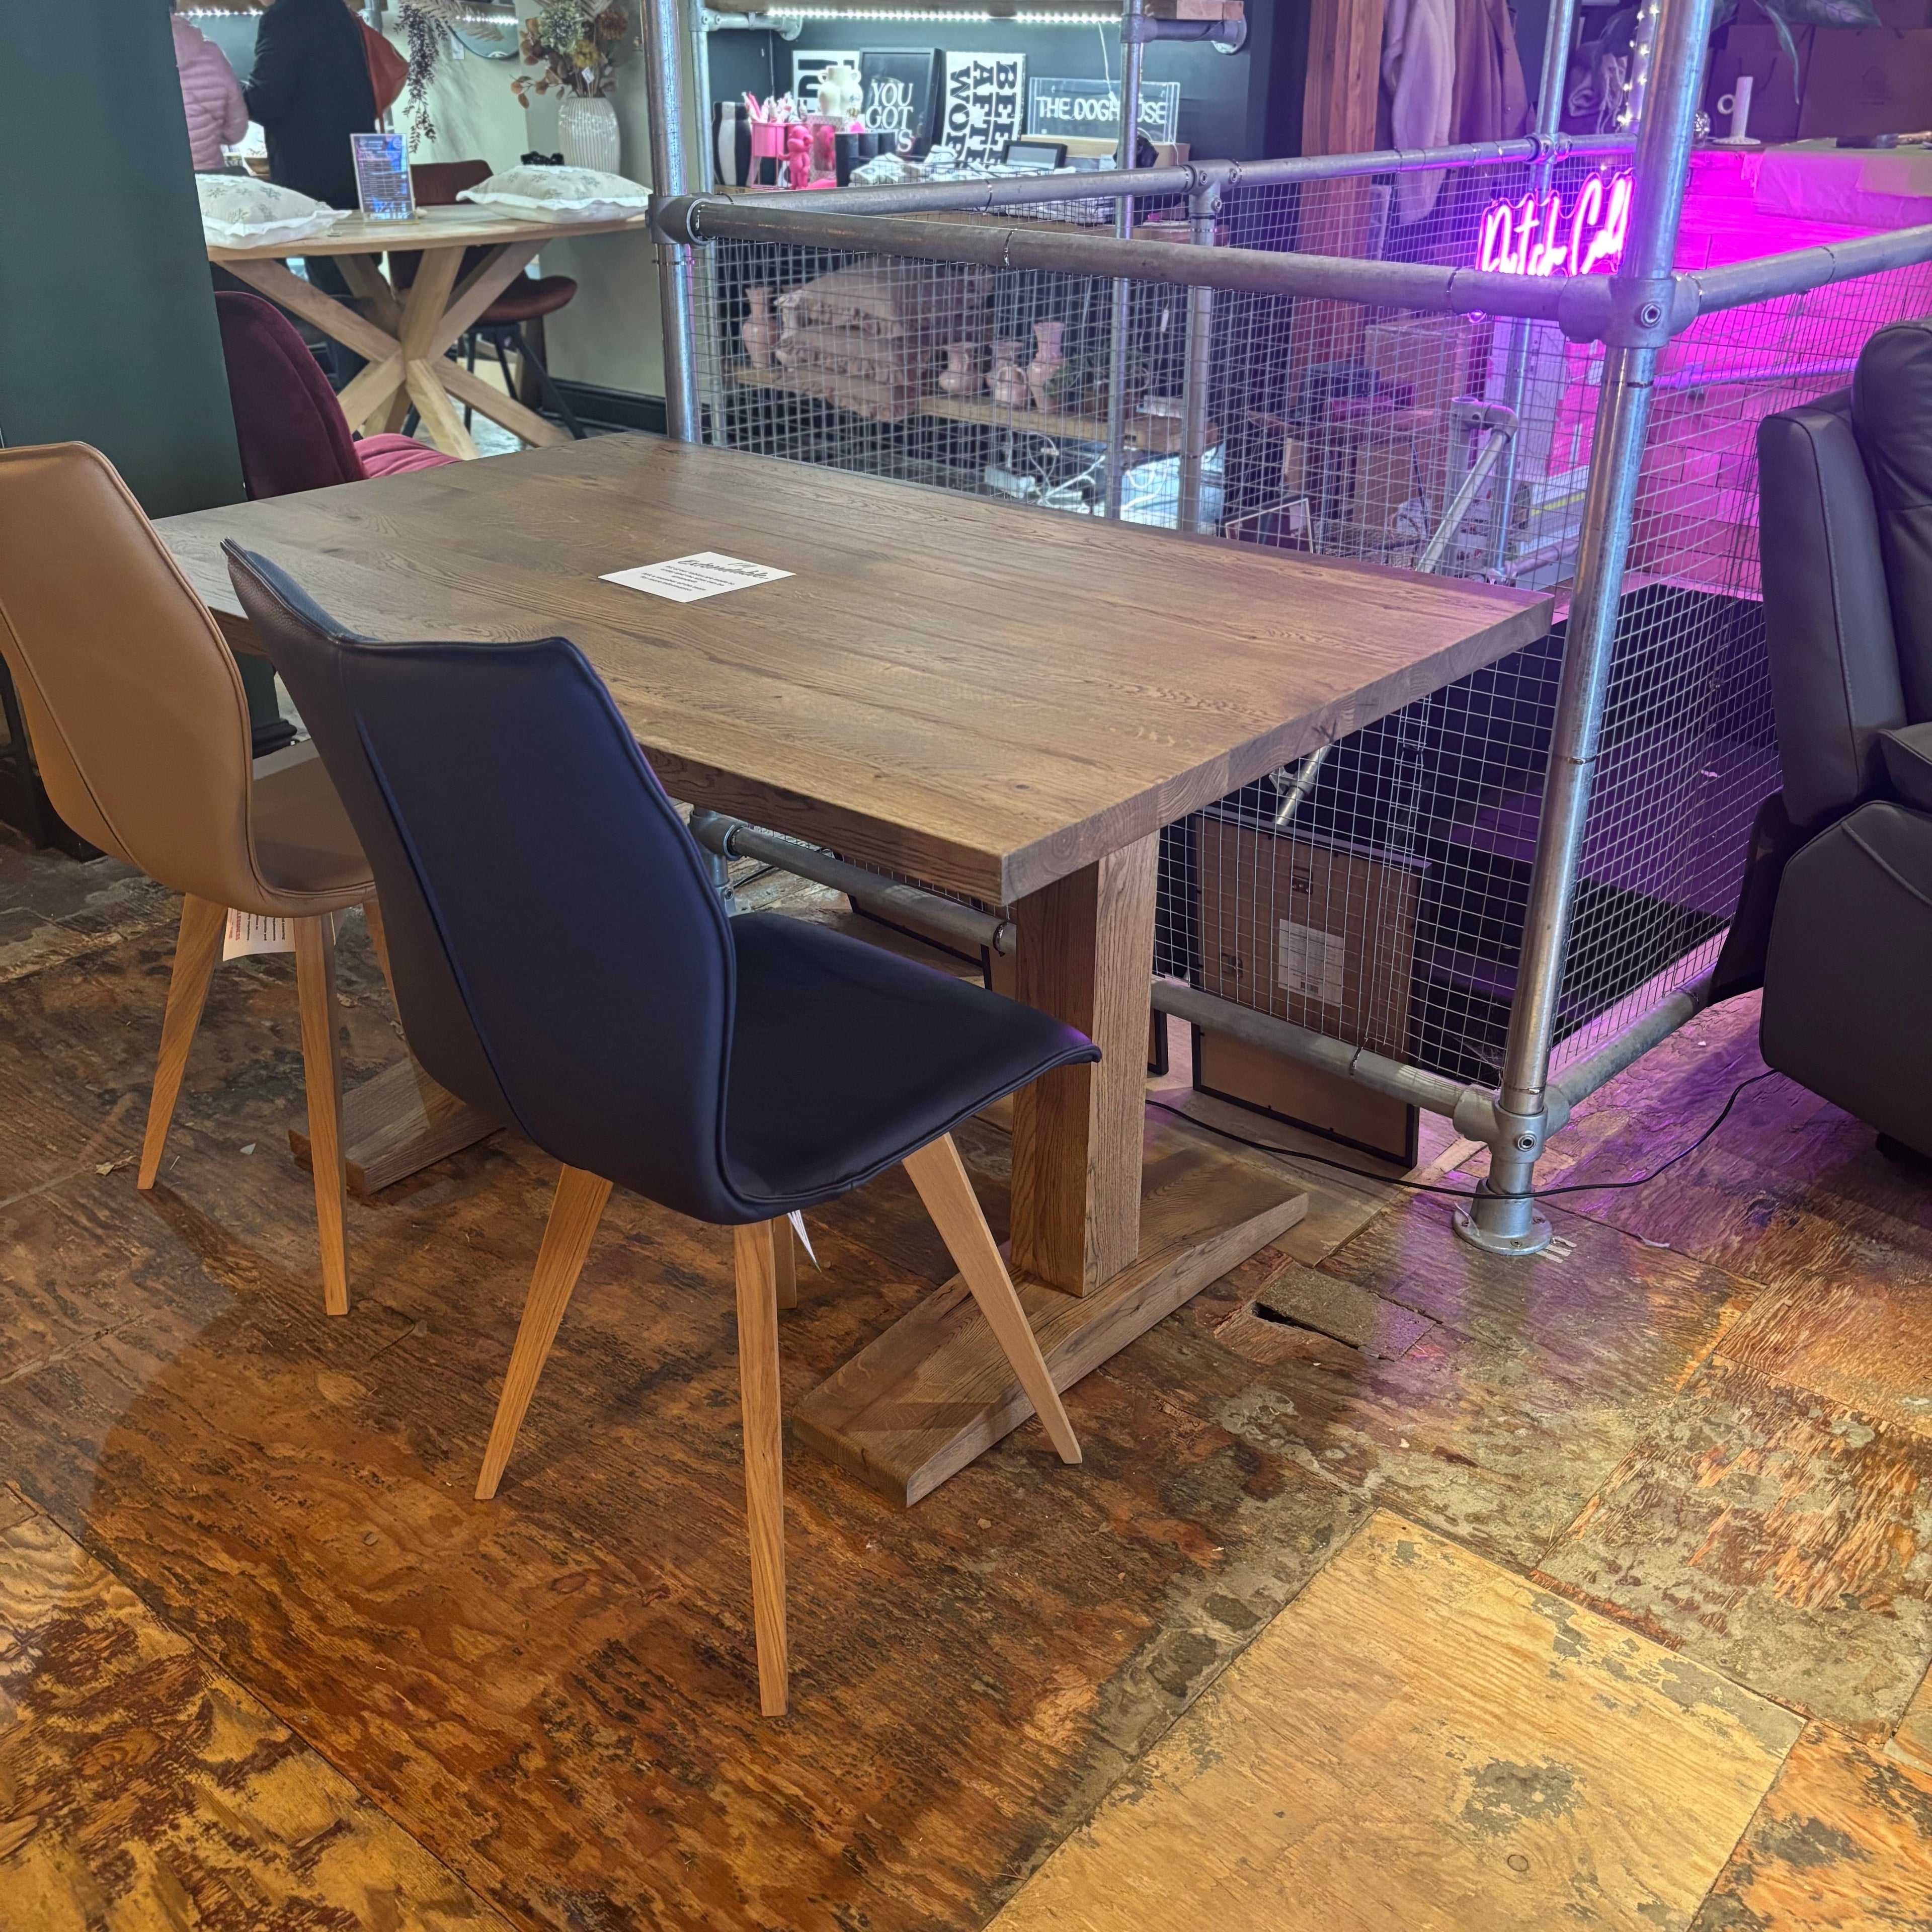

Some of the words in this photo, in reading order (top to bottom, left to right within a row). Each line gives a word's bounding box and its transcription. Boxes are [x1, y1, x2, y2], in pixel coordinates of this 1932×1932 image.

[871, 83, 913, 107] YOU
[865, 106, 914, 129] GOT
[1035, 96, 1071, 120] THE
